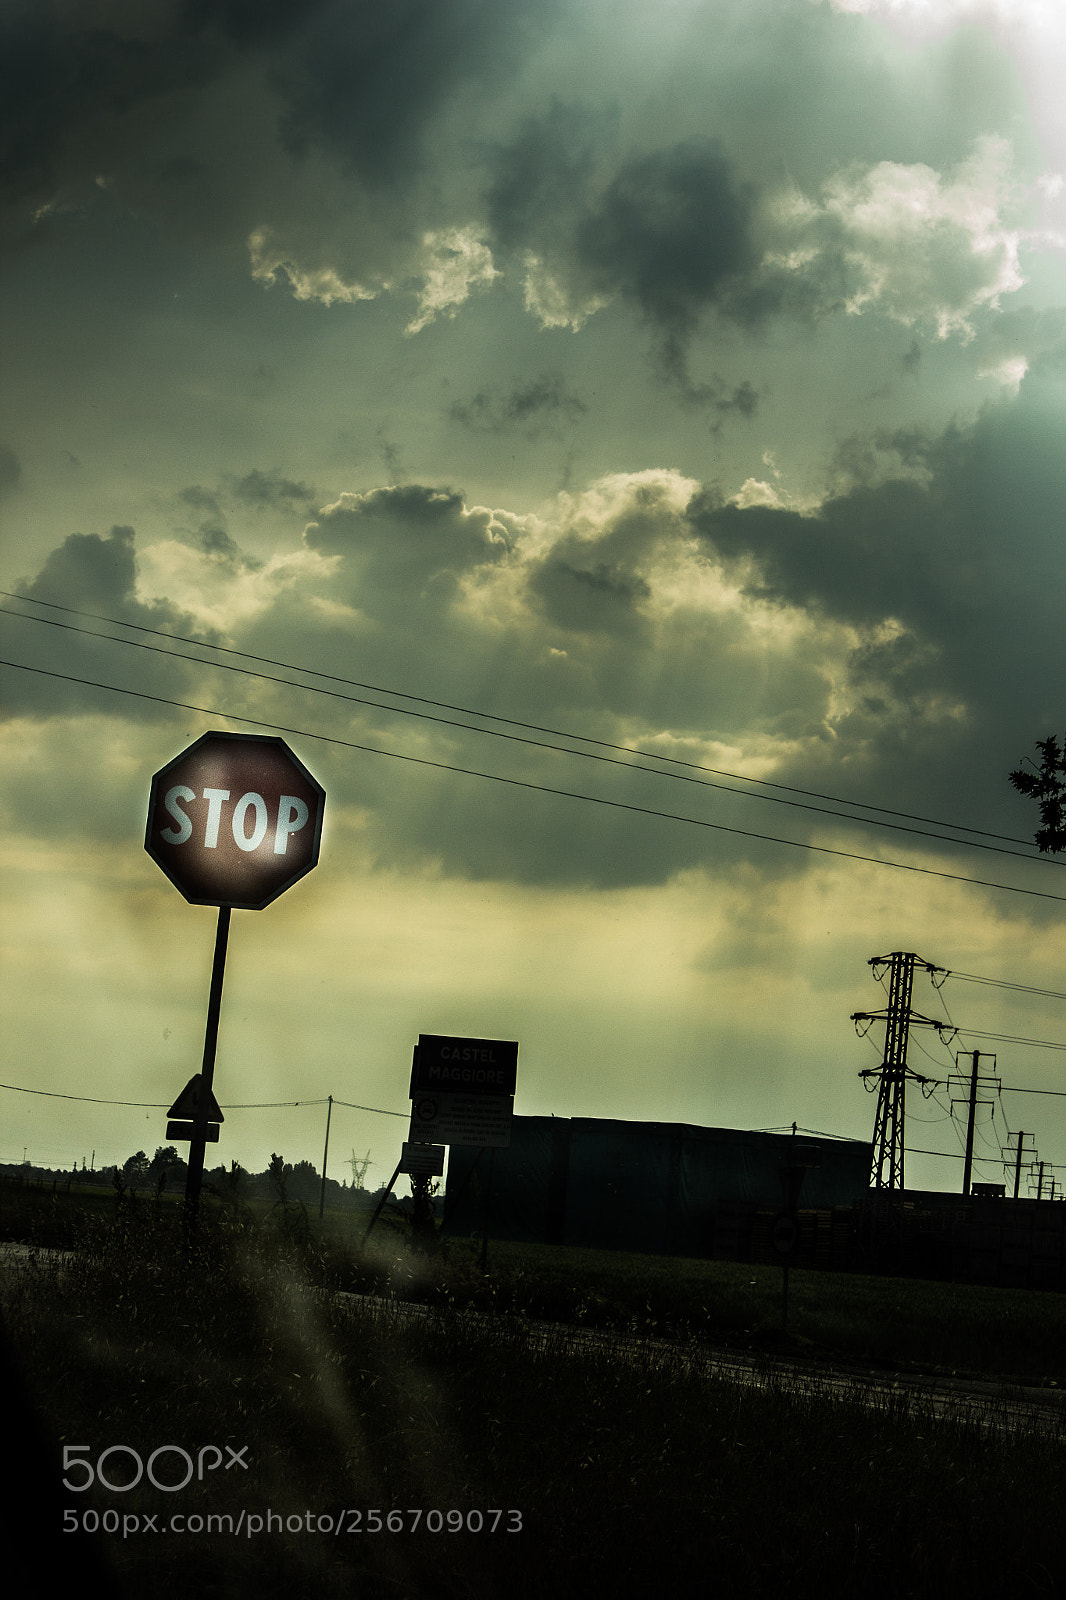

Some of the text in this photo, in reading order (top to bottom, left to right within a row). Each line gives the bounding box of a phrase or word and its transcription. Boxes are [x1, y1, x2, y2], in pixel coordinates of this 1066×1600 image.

[160, 785, 309, 855] STOP
[440, 1046, 497, 1063] CASTEL
[428, 1065, 505, 1085] MAGGIORE
